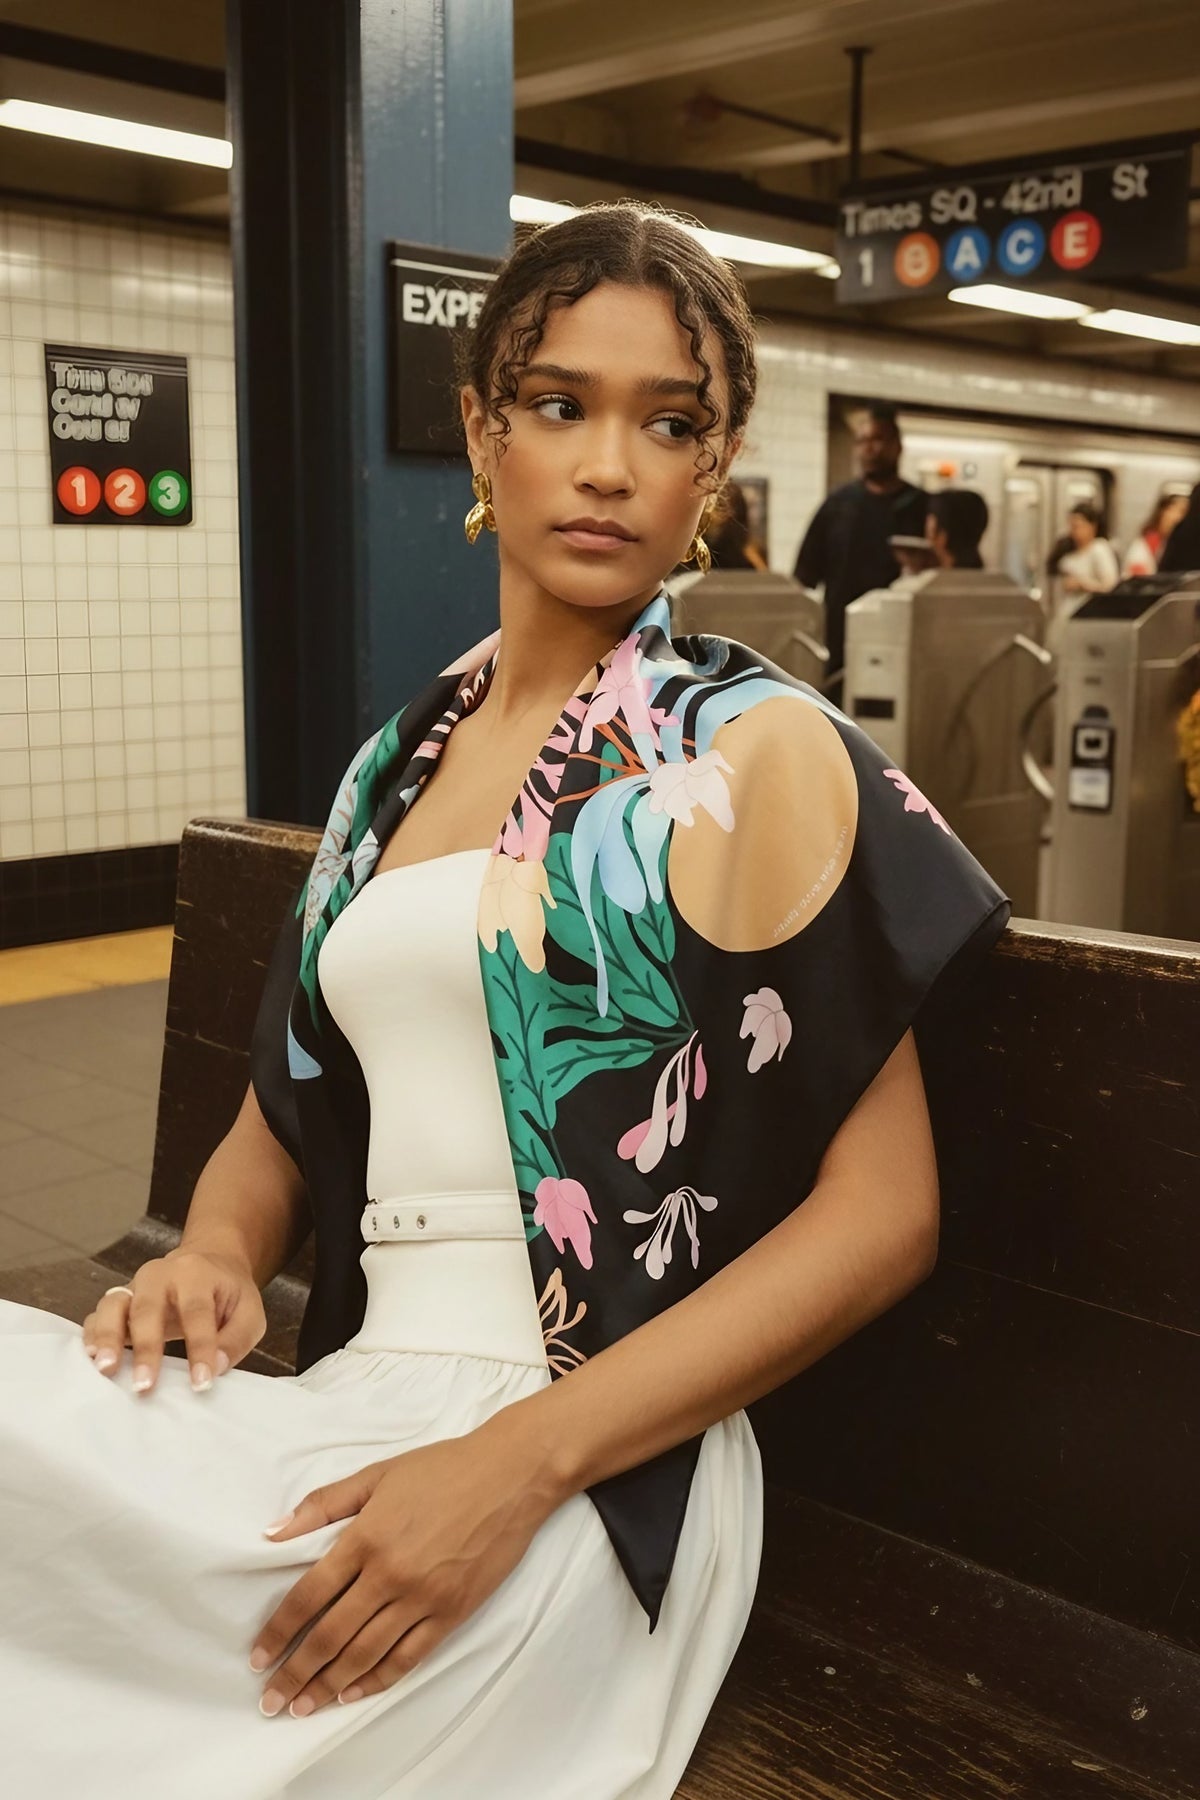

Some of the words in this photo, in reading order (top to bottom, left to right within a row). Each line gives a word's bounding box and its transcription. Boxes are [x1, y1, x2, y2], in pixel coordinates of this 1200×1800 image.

[1112, 163, 1149, 200] St
[859, 249, 873, 286] 1
[953, 236, 982, 271] A
[1006, 228, 1034, 265] C
[1063, 222, 1089, 259] E
[71, 474, 86, 507] 1
[113, 474, 136, 508] 2
[158, 476, 181, 510] 3
